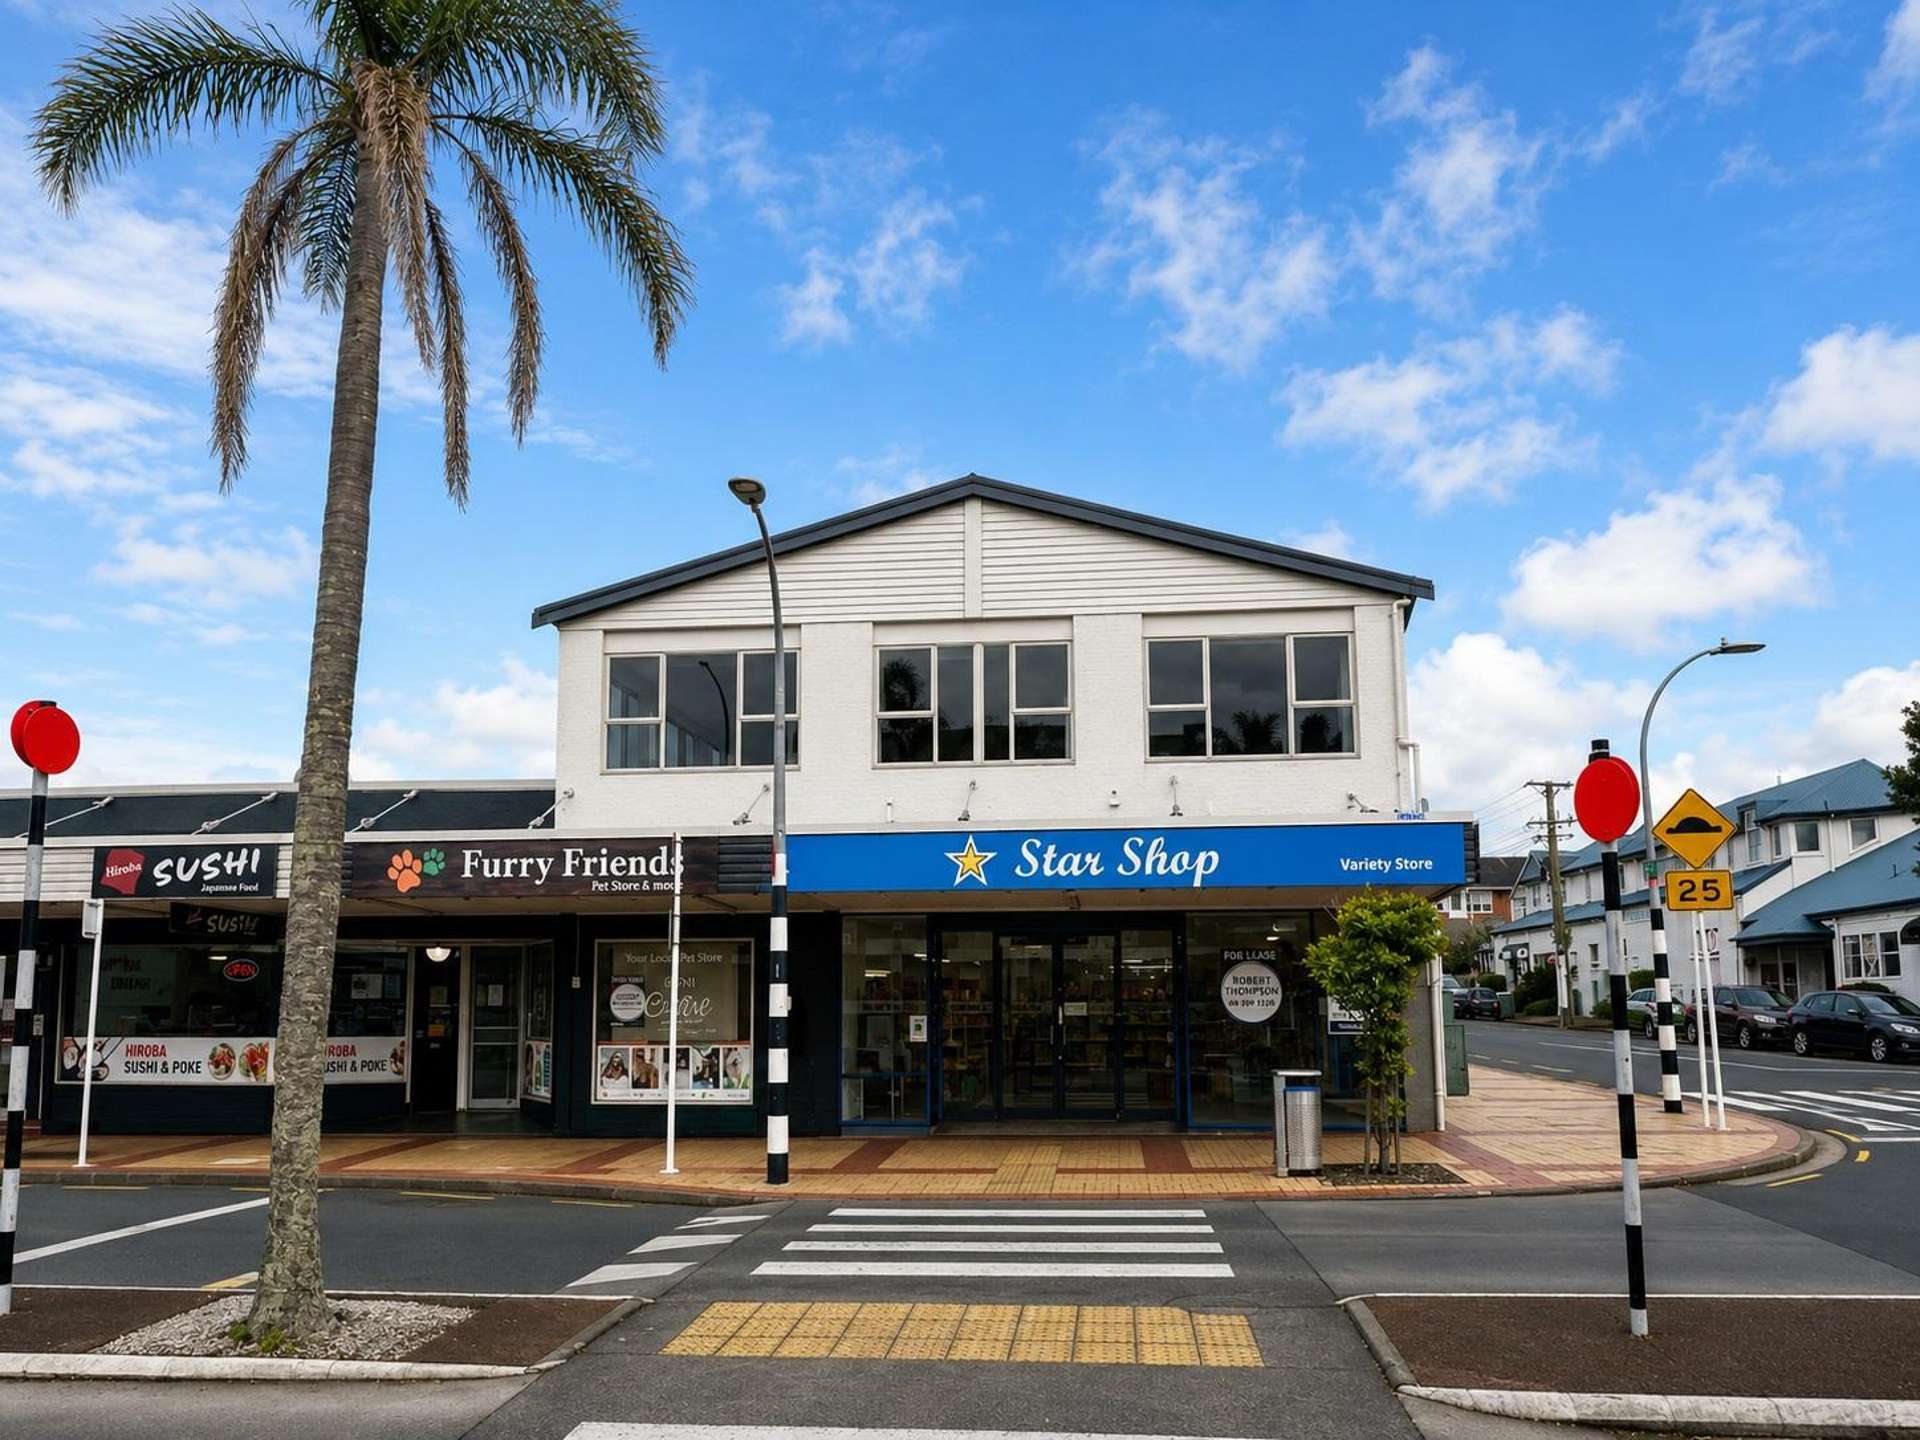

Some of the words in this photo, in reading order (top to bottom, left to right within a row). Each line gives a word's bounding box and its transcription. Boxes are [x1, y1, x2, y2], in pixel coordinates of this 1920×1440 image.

[152, 848, 261, 887] SUSHI
[461, 849, 554, 885] Furry
[1014, 838, 1104, 877] Star
[1116, 836, 1219, 887] Shop
[1340, 858, 1392, 873] Variety
[1395, 858, 1433, 870] Store
[105, 862, 142, 878] Hiroba
[201, 883, 238, 894] Japanese
[239, 882, 259, 892] Food
[592, 880, 608, 891] Pet
[612, 880, 640, 891] Store
[642, 880, 650, 890] &
[1679, 879, 1720, 902] 25
[1224, 951, 1243, 960] FOR
[126, 1044, 167, 1058] HIROBA
[124, 1060, 157, 1074] SUSHI
[161, 1060, 169, 1074] &
[173, 1060, 202, 1074] POKE
[350, 1061, 357, 1072] &
[361, 1059, 387, 1072] POKE
